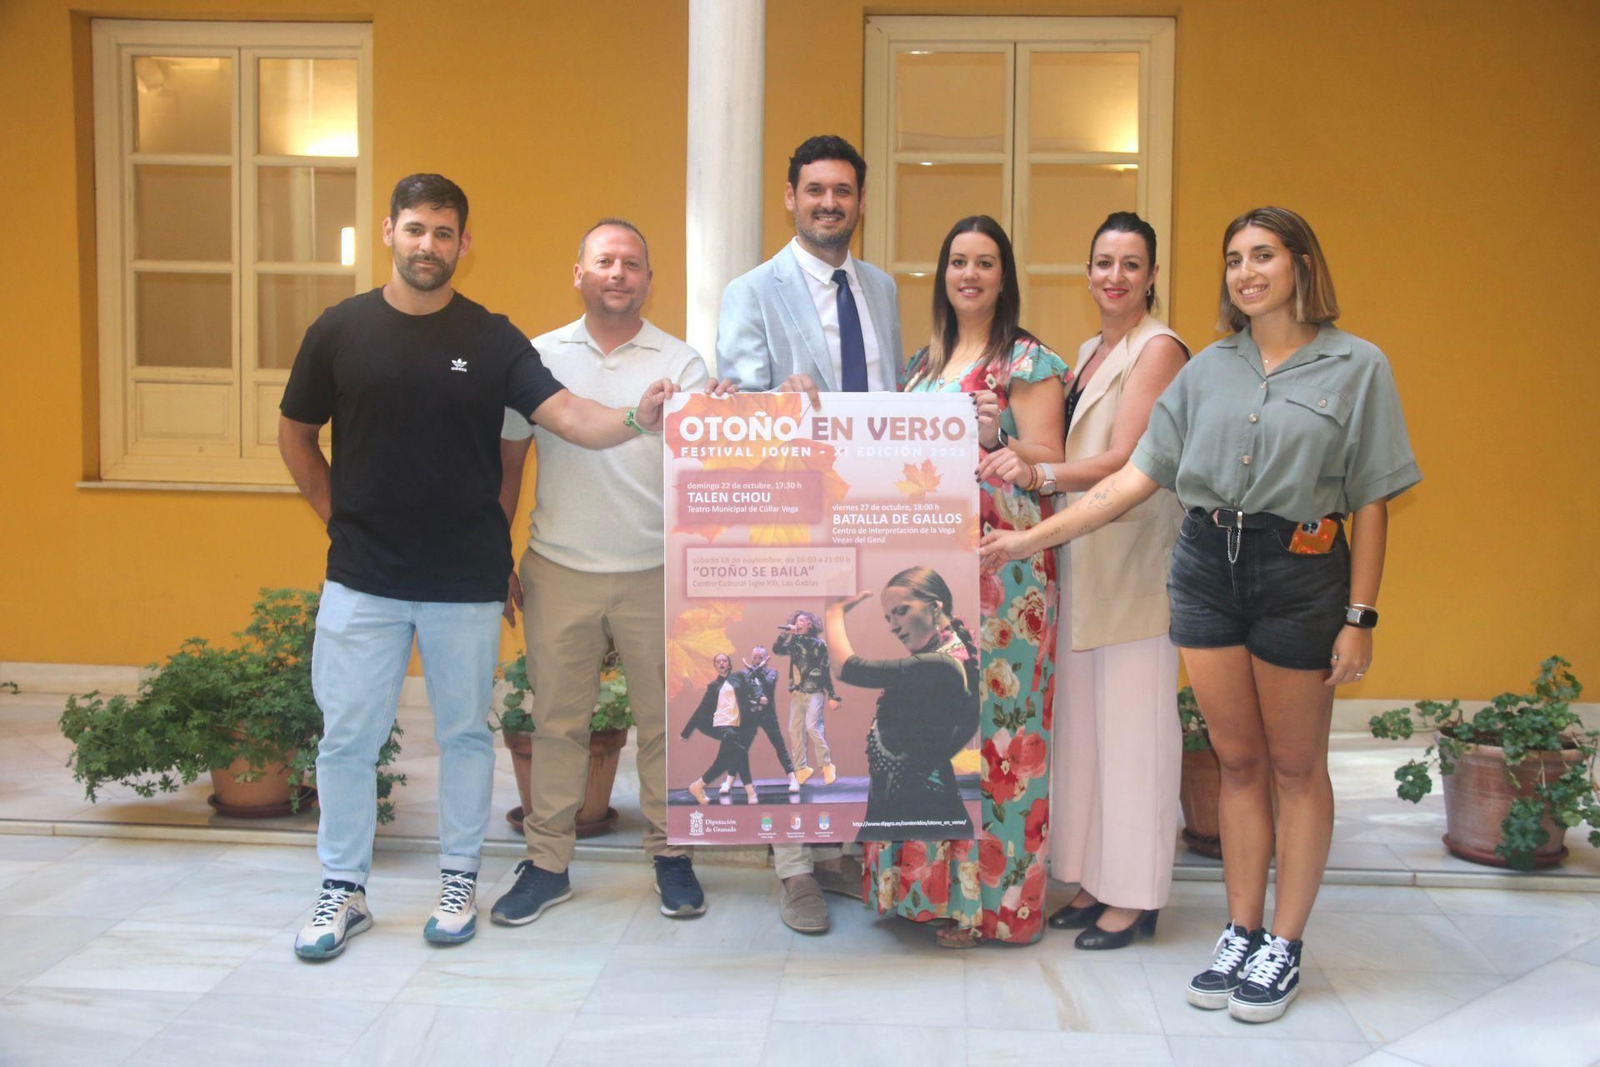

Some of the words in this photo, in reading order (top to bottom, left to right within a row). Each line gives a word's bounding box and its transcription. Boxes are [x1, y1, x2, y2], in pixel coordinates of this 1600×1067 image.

[679, 411, 797, 442] OTOÑO
[812, 416, 853, 440] EN
[867, 416, 966, 441] VERSO
[681, 447, 754, 457] FESTIVAL
[762, 447, 811, 457] JOVEN
[834, 447, 849, 457] XI
[857, 443, 922, 457] EDICIÓN
[930, 447, 965, 457] 2023
[687, 482, 719, 490] domingo
[743, 482, 773, 490] octubre,
[688, 492, 728, 502] TALEN
[732, 492, 771, 502] CHOU
[781, 506, 799, 514] Vega
[882, 504, 911, 512] octubre,
[833, 514, 888, 524] BATALLA
[892, 514, 908, 524] DE
[912, 513, 962, 524] GALLOS
[869, 527, 918, 535] Interpretación
[731, 556, 741, 564] de
[742, 556, 784, 565] noviembre,
[693, 564, 748, 577] “OTOÑO
[752, 566, 766, 577] SE
[771, 566, 815, 577] BAILA”
[748, 580, 765, 589] Siglo
